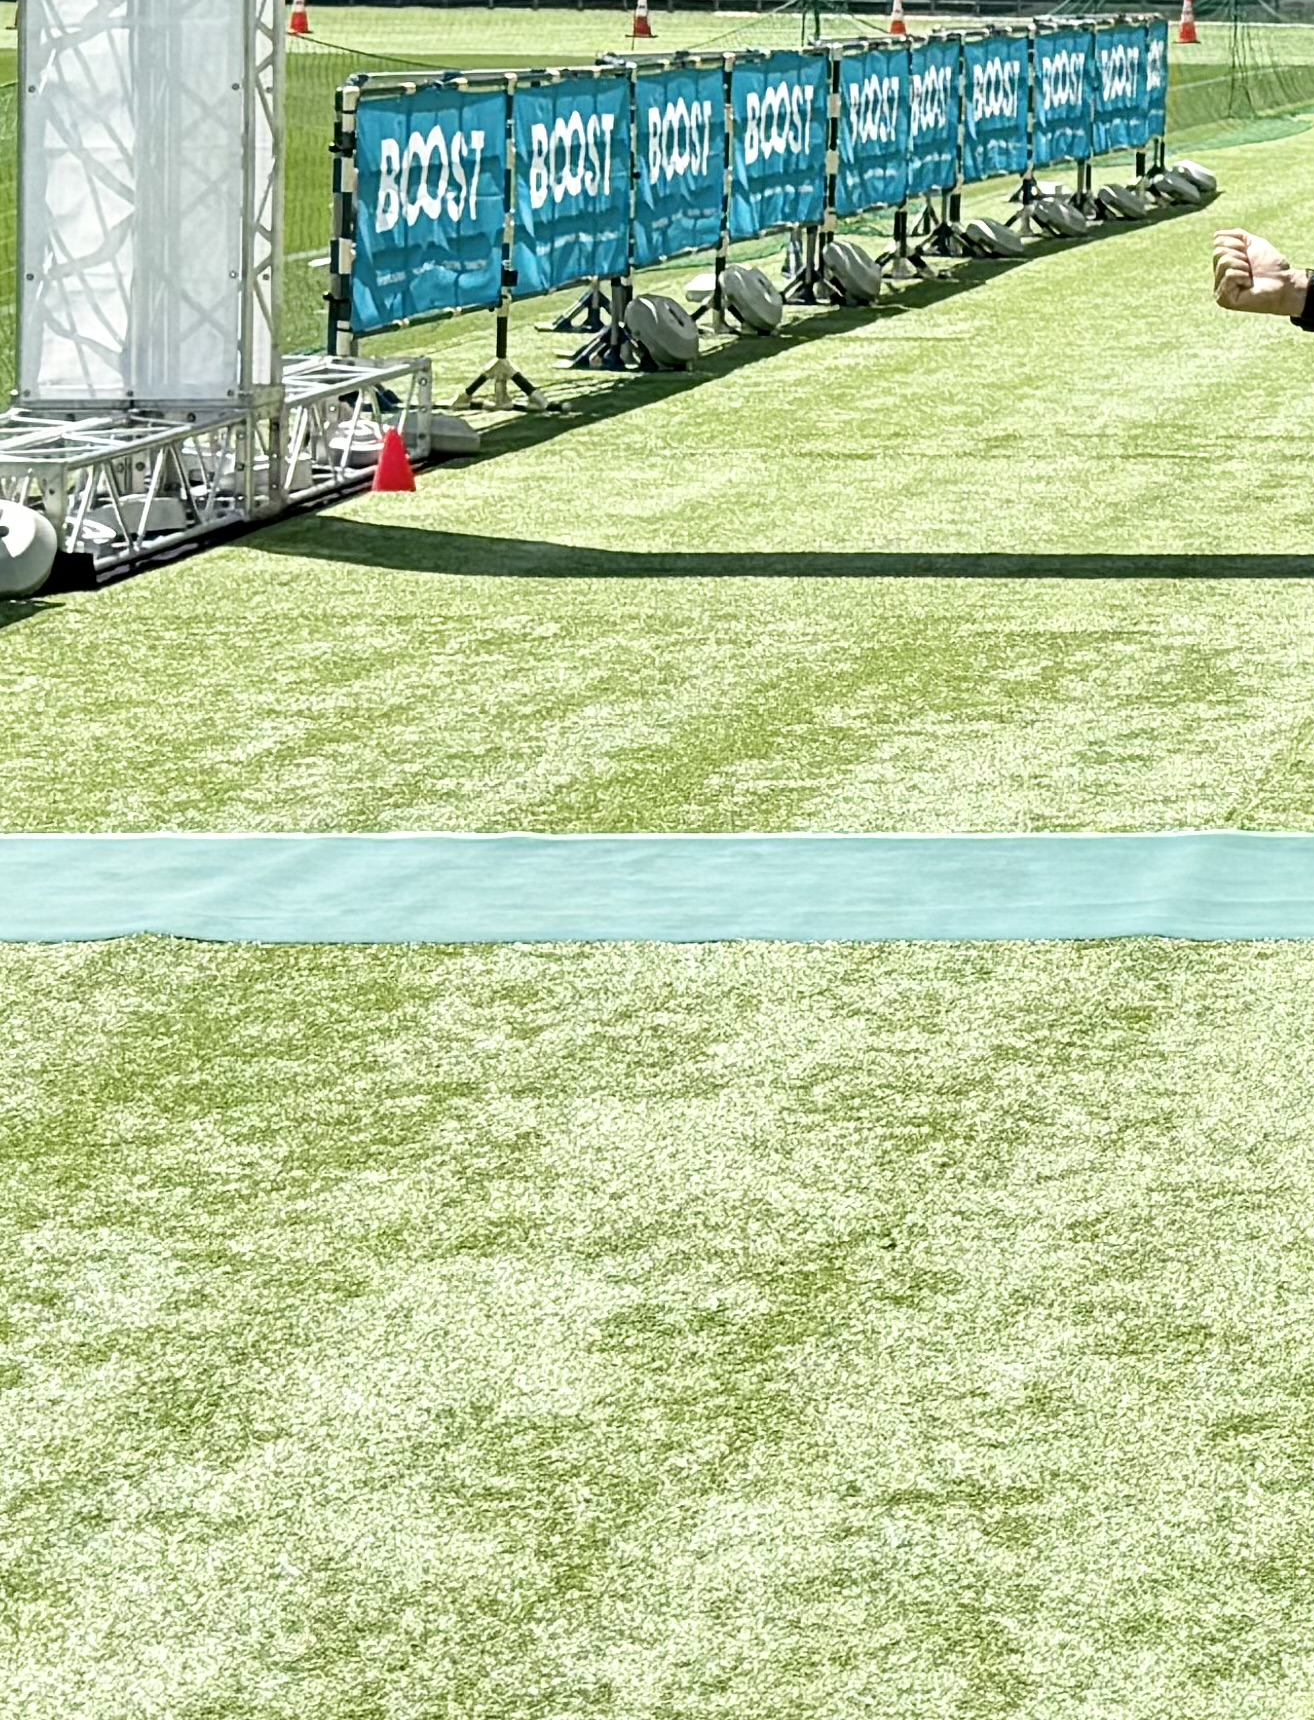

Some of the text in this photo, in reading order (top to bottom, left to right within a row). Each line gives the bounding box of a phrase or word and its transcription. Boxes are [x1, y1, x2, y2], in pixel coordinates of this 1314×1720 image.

[743, 80, 814, 166] BOOST
[973, 57, 1020, 122] BOOST
[375, 124, 485, 234] BOOST
[529, 110, 615, 210] BOOST
[648, 96, 713, 185] BOOST
